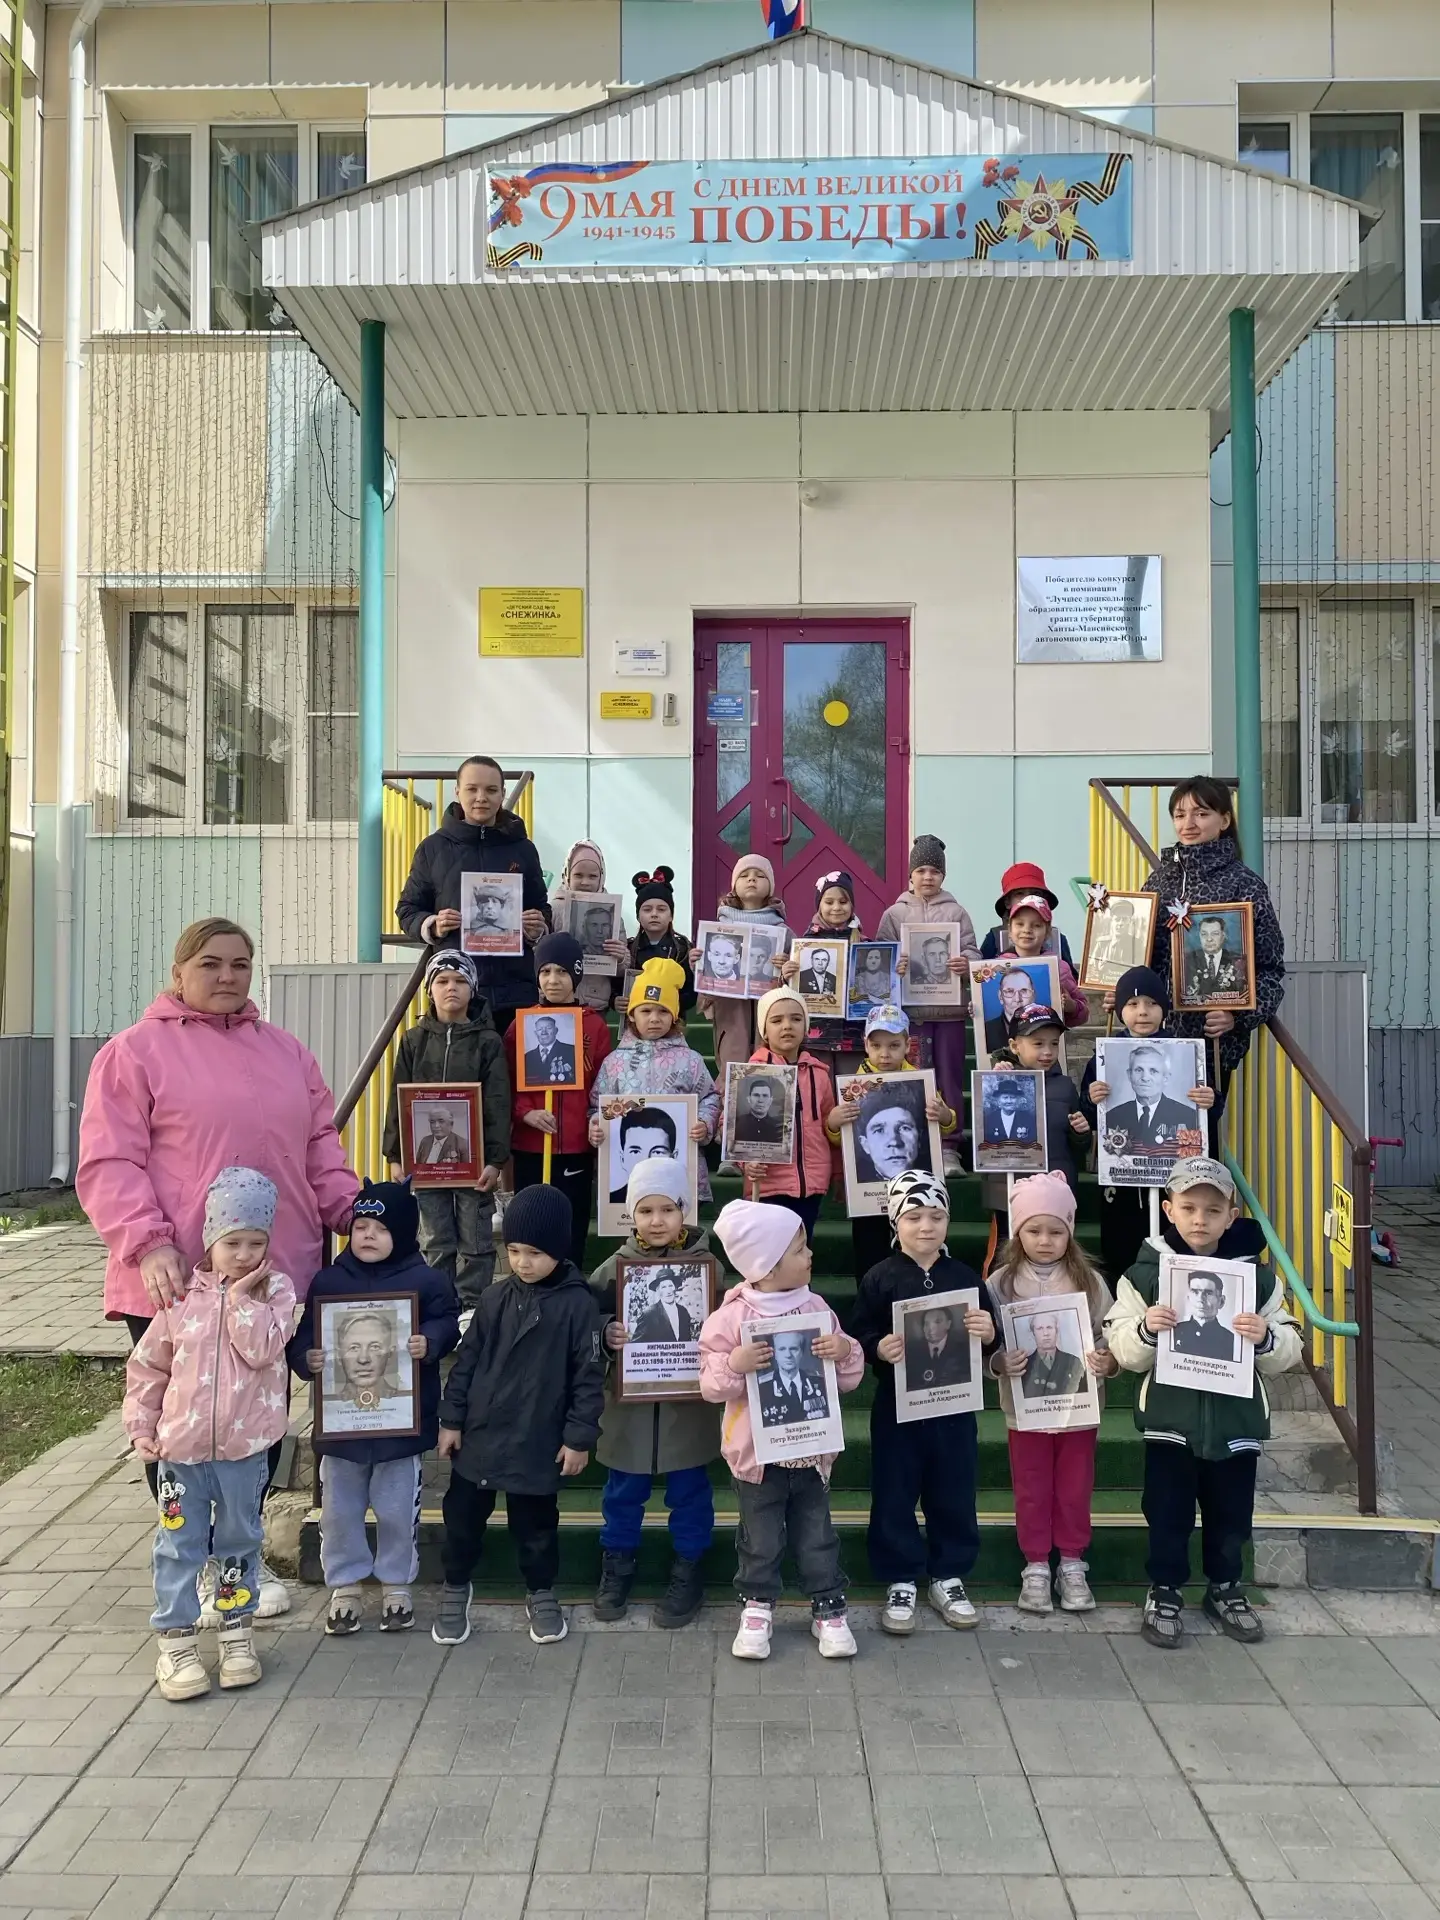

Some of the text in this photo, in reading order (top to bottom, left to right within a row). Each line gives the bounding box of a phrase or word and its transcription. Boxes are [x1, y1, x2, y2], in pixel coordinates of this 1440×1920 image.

[694, 170, 964, 201] С ДНЕМ ВЕЛИКОЙ
[540, 184, 676, 242] 9 МАЯ
[689, 202, 967, 250] ПОБЕДЫ!
[583, 226, 676, 240] 1941-1945
[1045, 576, 1136, 584] Победителю конкурса
[500, 610, 561, 618] «СНЕЖИНКА»
[1028, 605, 1096, 613] образовательное
[1080, 616, 1131, 624] губернатора
[1090, 634, 1148, 644] округа-Югры
[1184, 1358, 1228, 1370] Александров
[785, 1425, 810, 1434] Захаров
